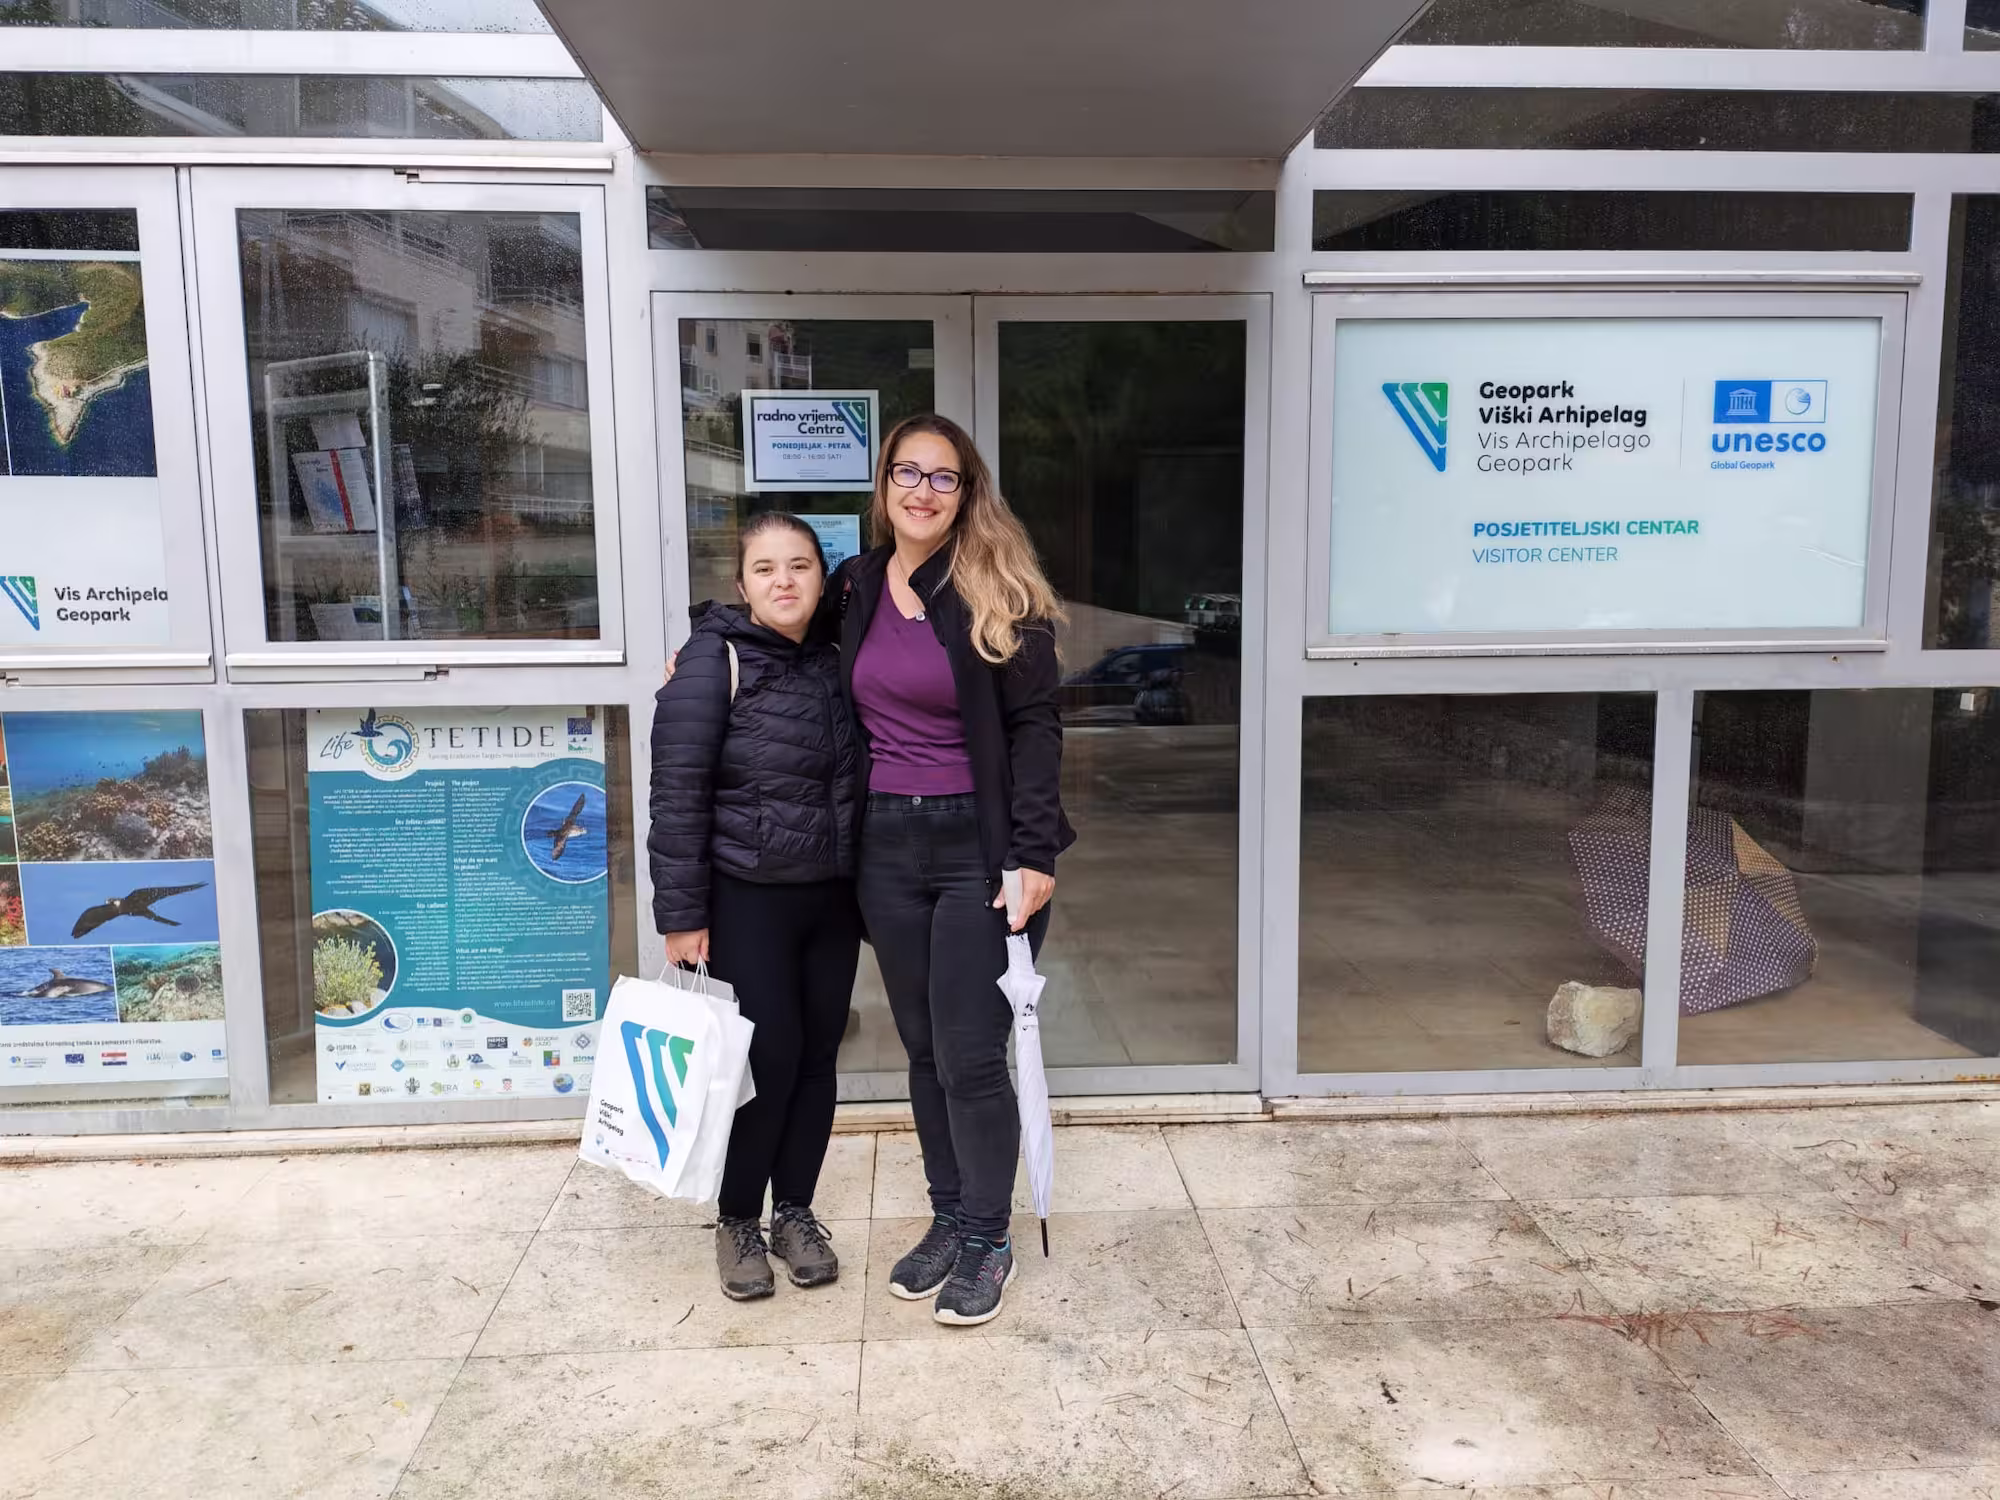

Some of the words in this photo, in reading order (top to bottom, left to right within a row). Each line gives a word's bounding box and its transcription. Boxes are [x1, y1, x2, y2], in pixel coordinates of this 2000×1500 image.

[1479, 380, 1575, 403] Geopark
[757, 408, 796, 422] radno
[1479, 405, 1533, 425] Viški
[1538, 404, 1648, 428] Arhipelag
[797, 421, 845, 435] Centra
[771, 442, 822, 451] PONEDJELJAK
[1477, 431, 1509, 450] Vis
[1515, 429, 1652, 453] Archipelago
[1711, 432, 1827, 453] unesco
[1477, 453, 1574, 476] Geopark
[1710, 460, 1738, 470] Global
[1739, 460, 1776, 472] Geopark
[1473, 520, 1621, 537] POSJETITELJSKI
[1626, 519, 1700, 536] CENTAR
[1471, 547, 1543, 564] VISITOR
[1547, 546, 1619, 563] CENTER
[54, 586, 82, 601] Vis
[56, 607, 131, 625] Geopark
[320, 731, 354, 759] Life
[424, 726, 555, 749] TETIDE
[600, 1099, 624, 1115] Geopark
